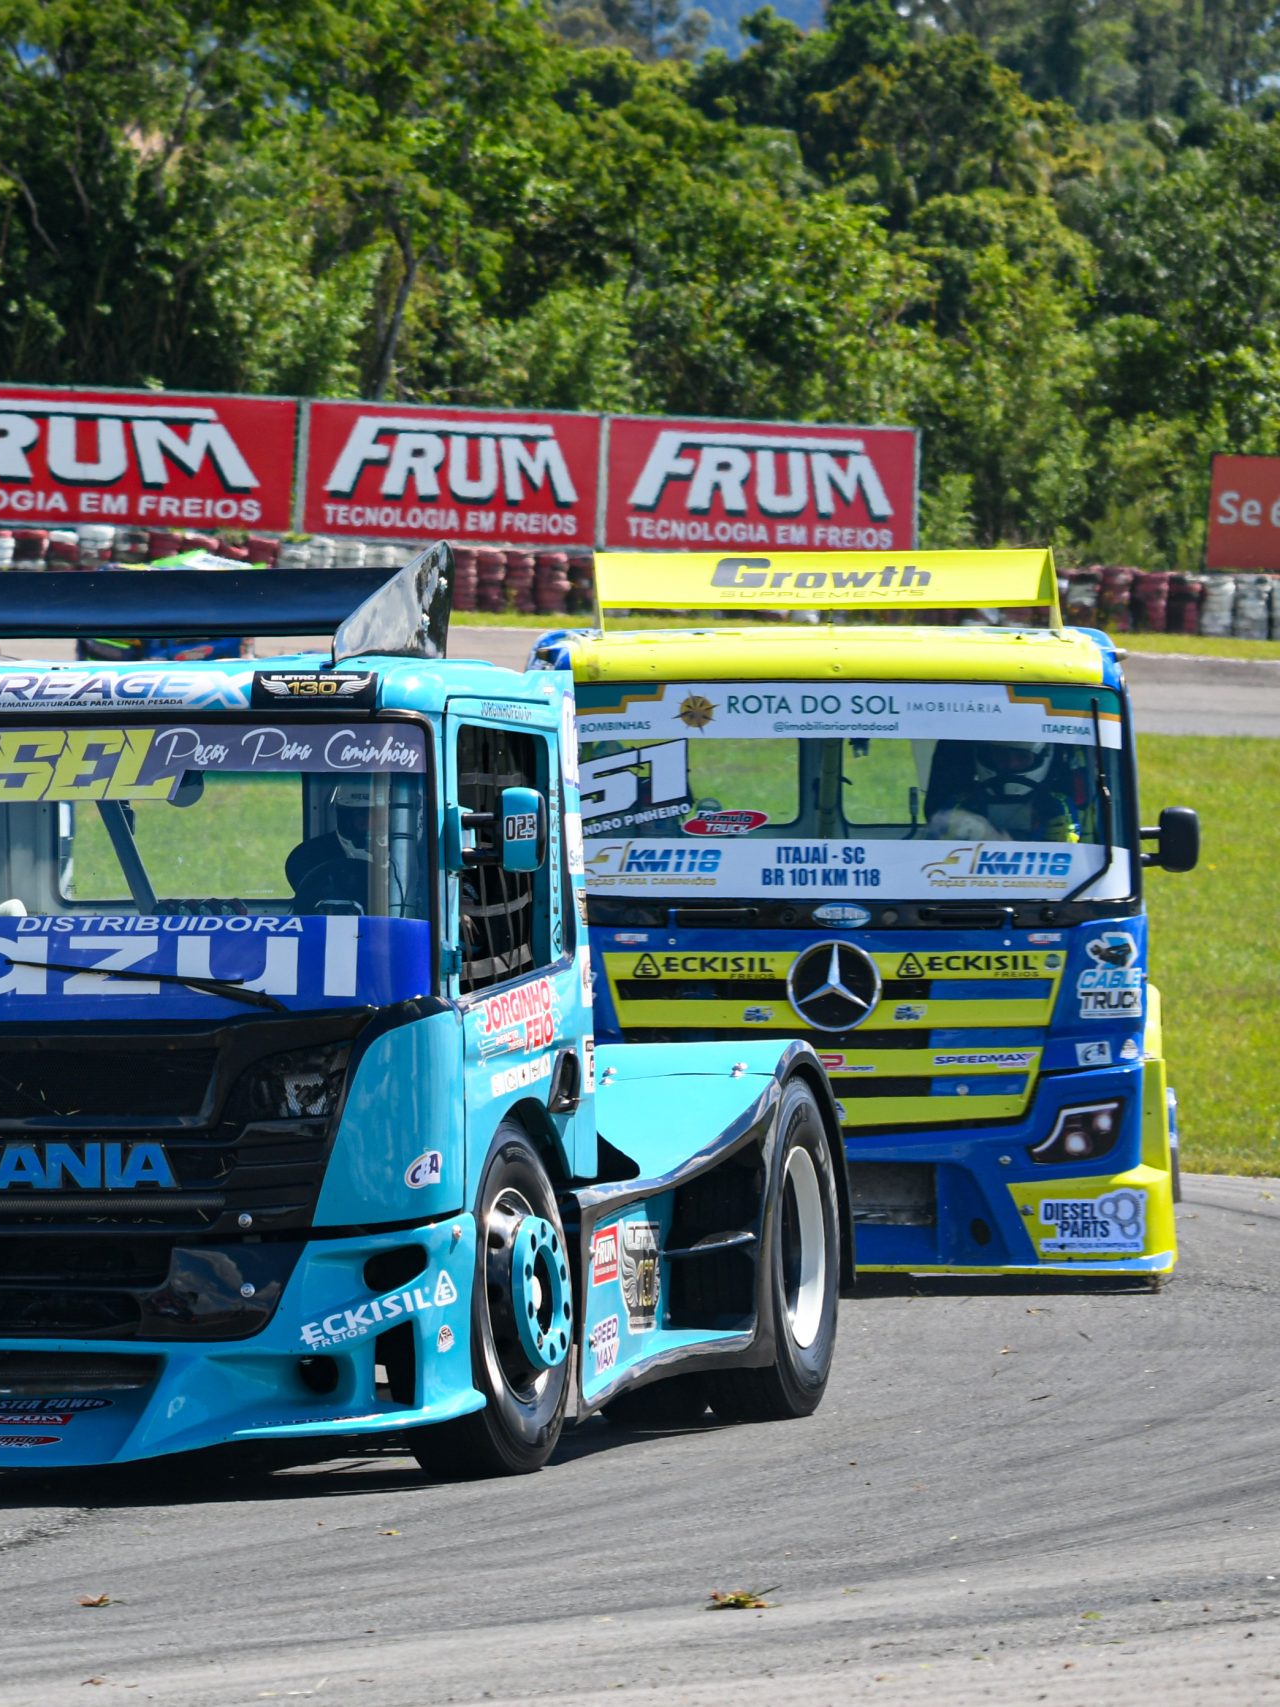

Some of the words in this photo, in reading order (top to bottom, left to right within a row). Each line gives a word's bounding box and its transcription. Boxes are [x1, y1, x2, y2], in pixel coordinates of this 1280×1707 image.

[323, 416, 579, 503] FRUM
[627, 431, 894, 517] FRUM
[79, 491, 128, 516] EM
[138, 495, 261, 522] FREIOS
[1217, 491, 1262, 526] Se
[323, 503, 460, 532] TECNOLOGIA
[465, 511, 495, 532] EM
[500, 512, 577, 536] FREIOS
[627, 516, 769, 543] TECNOLOGIA
[775, 524, 808, 546] EM
[813, 525, 893, 549] FREIOS
[710, 558, 932, 589] Growth
[720, 589, 925, 599] SUPPLEMENTS
[287, 681, 337, 695] 130
[727, 695, 792, 714] ROTA
[801, 695, 841, 714] DO
[851, 695, 900, 715] SOL
[580, 721, 651, 734] BOMBINHAS
[1042, 723, 1091, 736] ITAPEMA
[505, 814, 537, 841] 023
[583, 818, 621, 836] NDRO
[624, 804, 691, 827] PINHEIRO
[705, 823, 749, 835] TRUCK
[624, 849, 722, 874] KM118
[776, 843, 828, 865] ITAJAÍ
[843, 847, 865, 865] SC
[977, 852, 1072, 876] KM118
[762, 868, 784, 886] BR
[788, 869, 817, 886] 101
[821, 869, 848, 886] KM
[852, 869, 880, 886] 118
[16, 916, 305, 933] DISTRIBUIDORA
[662, 957, 774, 973] ECKISIL
[926, 954, 1038, 971] ECKISIL
[1080, 969, 1140, 989] CABLE
[484, 980, 551, 1034] JORGINHO
[1081, 991, 1140, 1010] TRUCK
[525, 1012, 554, 1051] FEIO
[934, 1052, 1026, 1066] SPEEDMAX
[1044, 1203, 1096, 1220] DIESEL
[1061, 1220, 1110, 1238] PARTS
[300, 1288, 433, 1345] ECKISIL
[312, 1326, 368, 1351] FREIOS
[594, 1317, 618, 1349] SPEED
[45, 1398, 105, 1409] POWER
